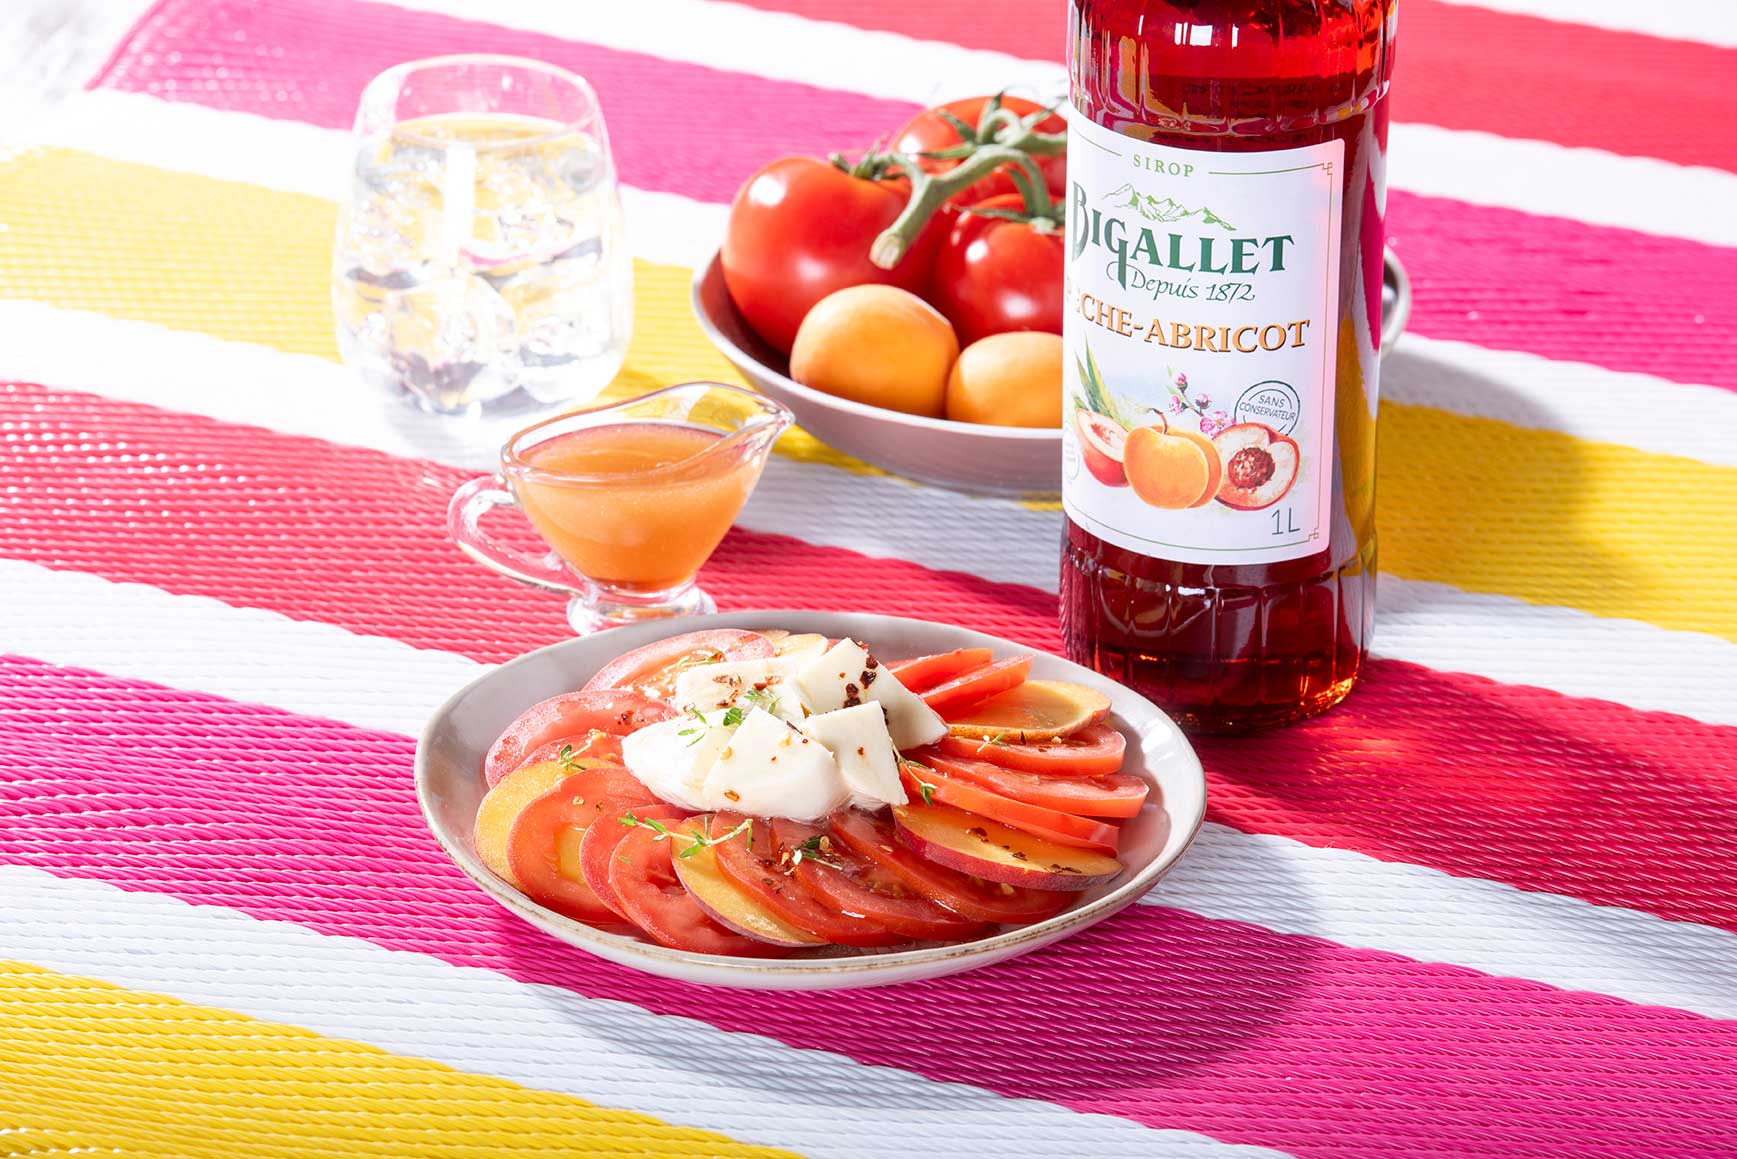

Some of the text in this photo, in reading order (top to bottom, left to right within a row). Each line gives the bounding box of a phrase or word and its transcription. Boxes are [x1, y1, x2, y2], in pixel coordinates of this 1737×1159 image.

[1133, 153, 1195, 178] SIROP
[1072, 180, 1295, 291] BIGALLET
[1110, 262, 1256, 305] Depuis 1872
[1068, 280, 1311, 354] CHE-ABRICOT
[1239, 401, 1297, 422] CONSERVATEUR
[1258, 394, 1286, 409] SANS
